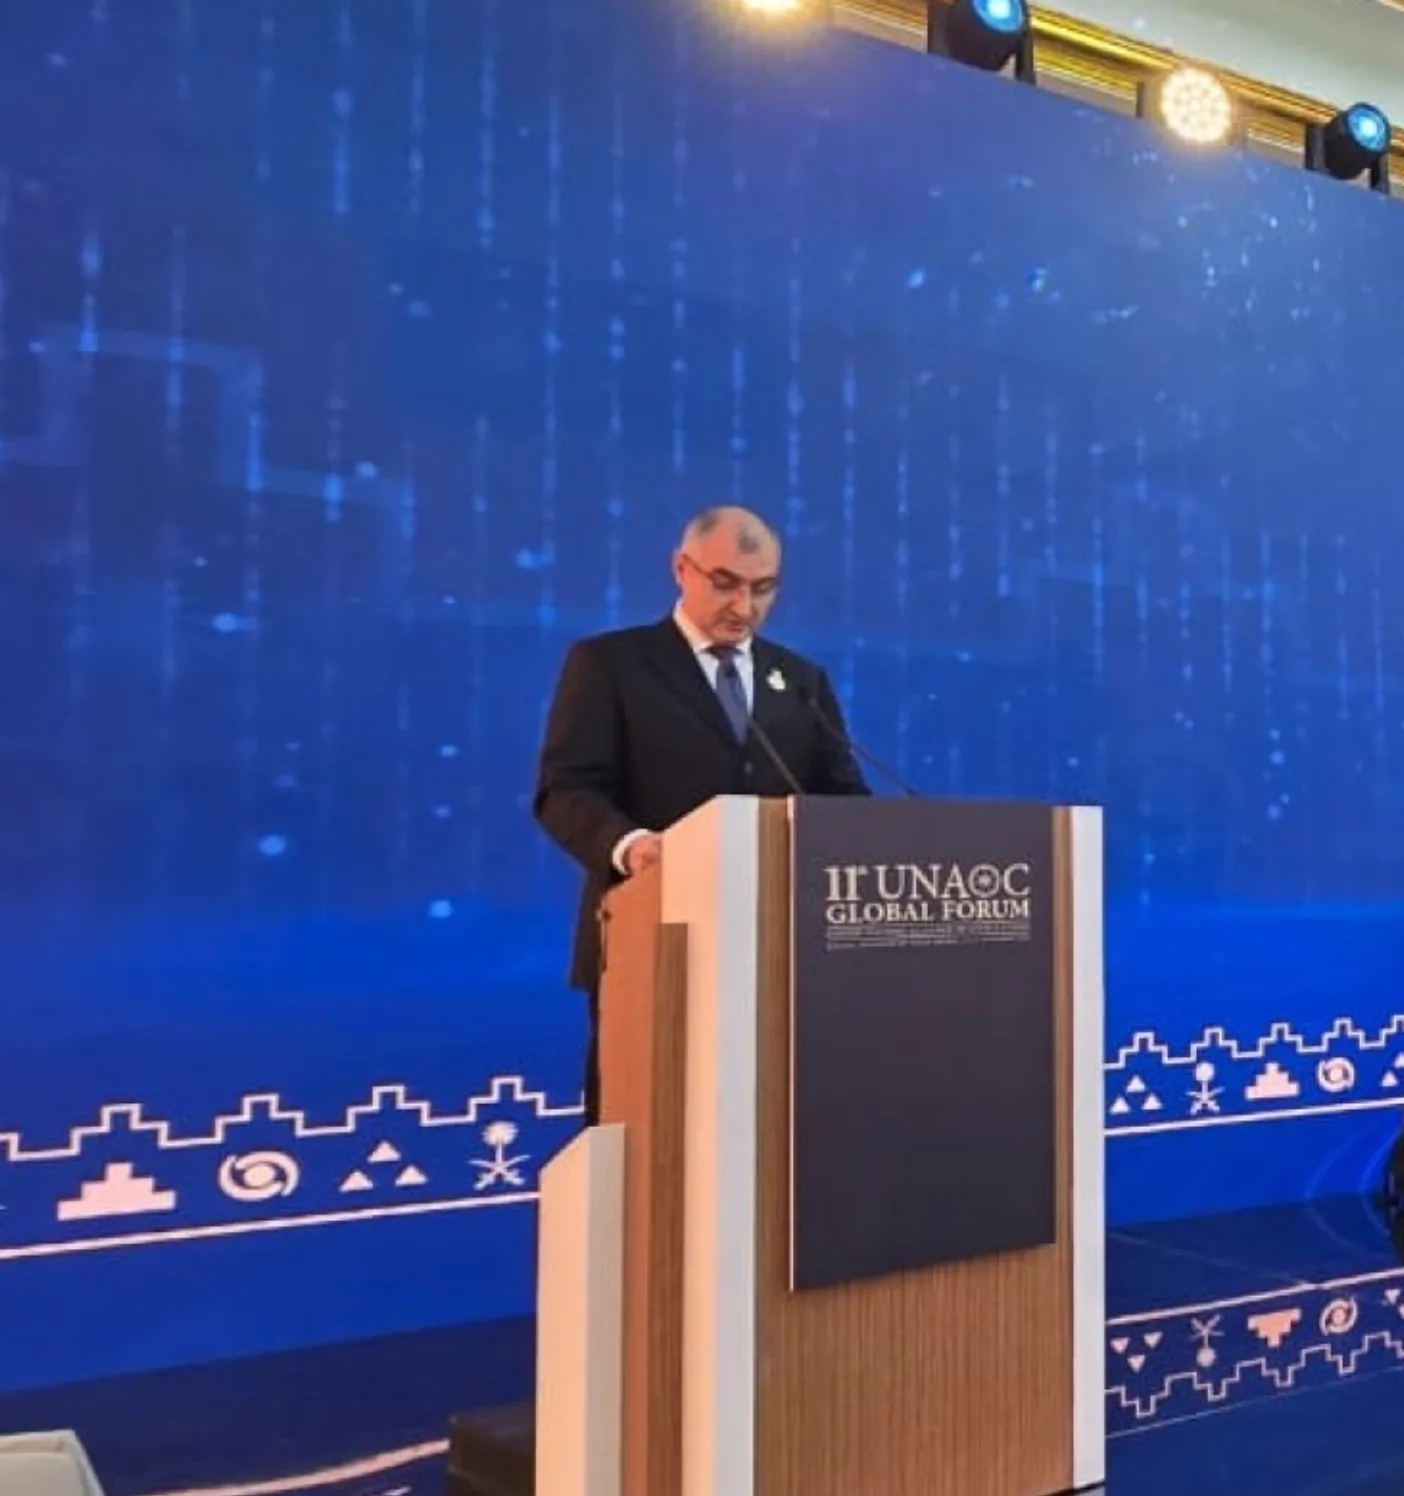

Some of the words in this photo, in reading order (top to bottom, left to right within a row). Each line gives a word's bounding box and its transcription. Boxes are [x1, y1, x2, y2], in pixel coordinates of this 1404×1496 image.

[874, 861, 1032, 899] UNAOC
[825, 901, 935, 925] GLOBAL
[941, 898, 1030, 922] FORUM
